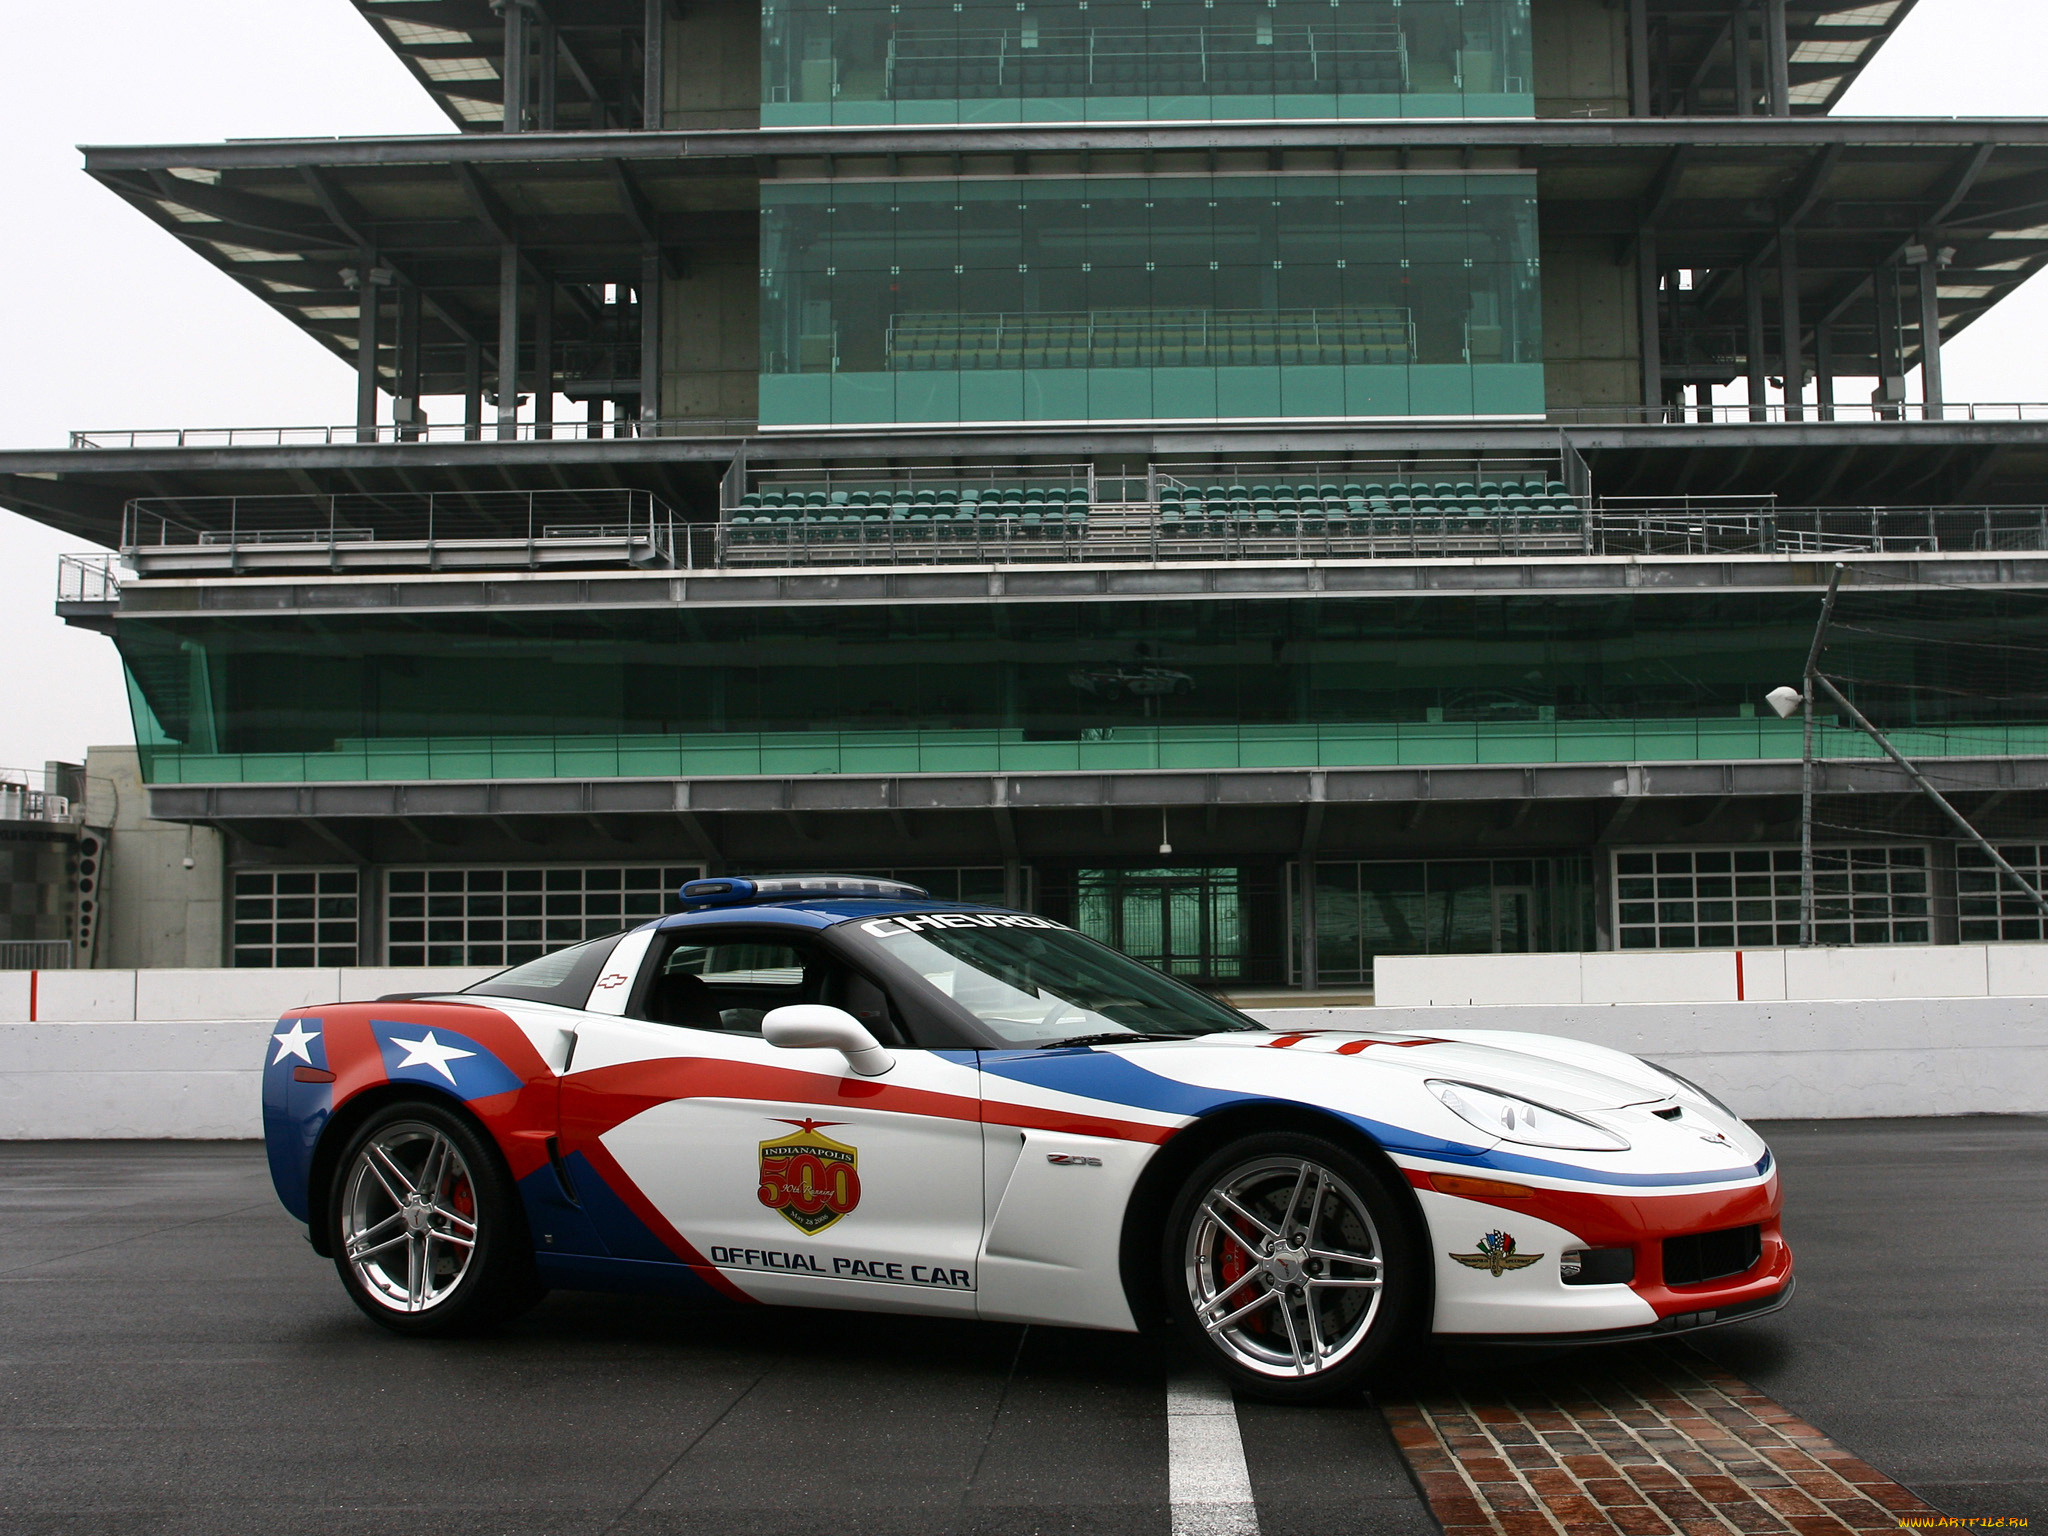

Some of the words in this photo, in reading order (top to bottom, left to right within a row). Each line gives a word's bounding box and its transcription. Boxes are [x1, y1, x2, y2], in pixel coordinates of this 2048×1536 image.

[765, 1147, 852, 1161] INDIANAPOLIS
[757, 1154, 861, 1214] 500
[803, 1183, 835, 1203] Running
[790, 1210, 804, 1224] May
[710, 1246, 826, 1272] OFFICIAL
[832, 1257, 904, 1280] PACE
[911, 1265, 971, 1287] CAR
